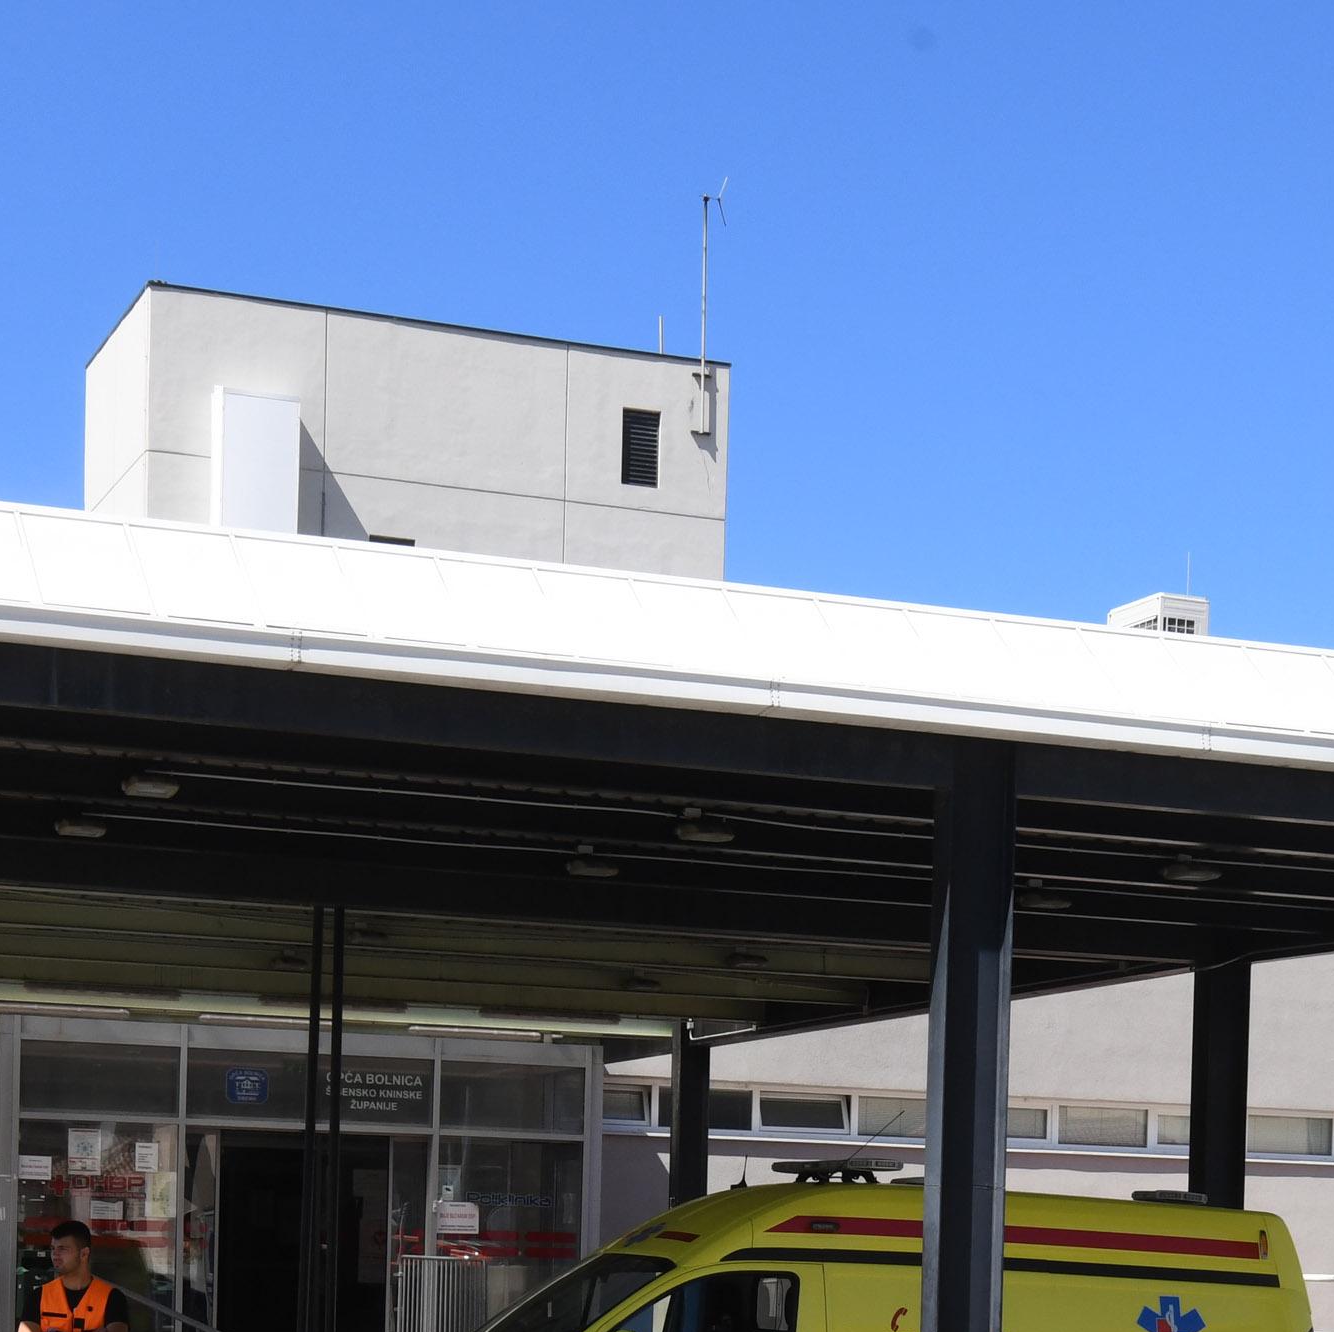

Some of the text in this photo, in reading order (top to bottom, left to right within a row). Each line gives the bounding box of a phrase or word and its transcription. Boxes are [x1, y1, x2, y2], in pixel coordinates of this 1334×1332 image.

[366, 1073, 423, 1086] BOLNICA
[379, 1089, 423, 1099] KNINSKE
[350, 1099, 398, 1111] ŽUPANIJE
[466, 1191, 554, 1208] Poliklinika
